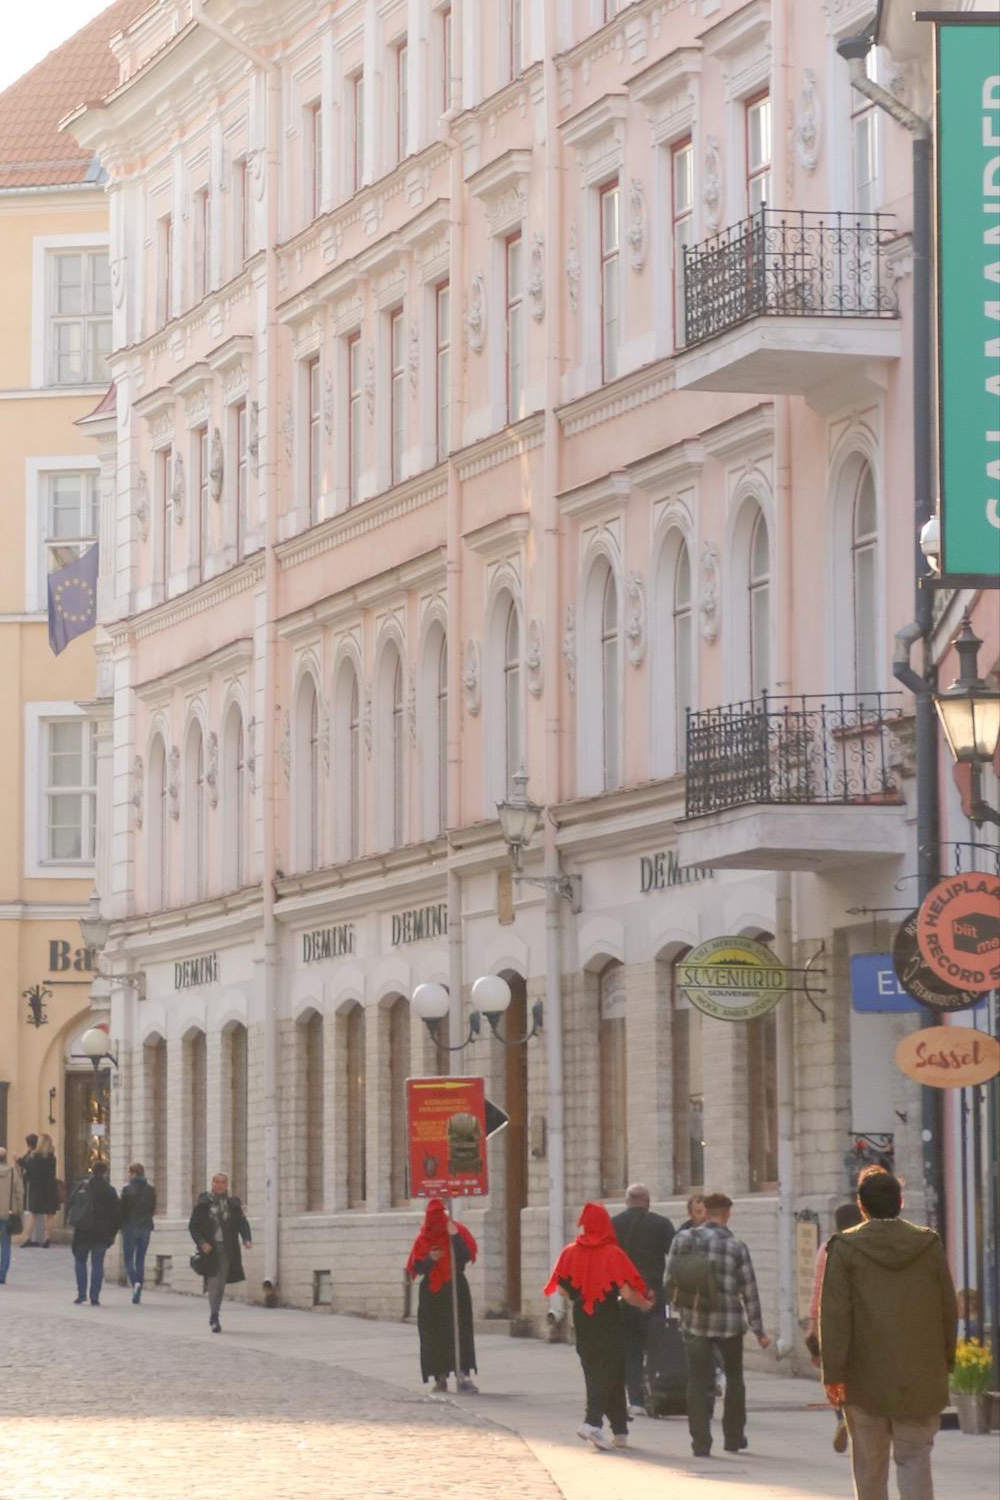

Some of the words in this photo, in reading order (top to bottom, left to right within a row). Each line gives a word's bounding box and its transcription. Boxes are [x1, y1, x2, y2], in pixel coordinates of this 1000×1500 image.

[952, 921, 979, 939] biit
[926, 933, 985, 984] RECORD
[915, 1040, 985, 1069] Sessel
